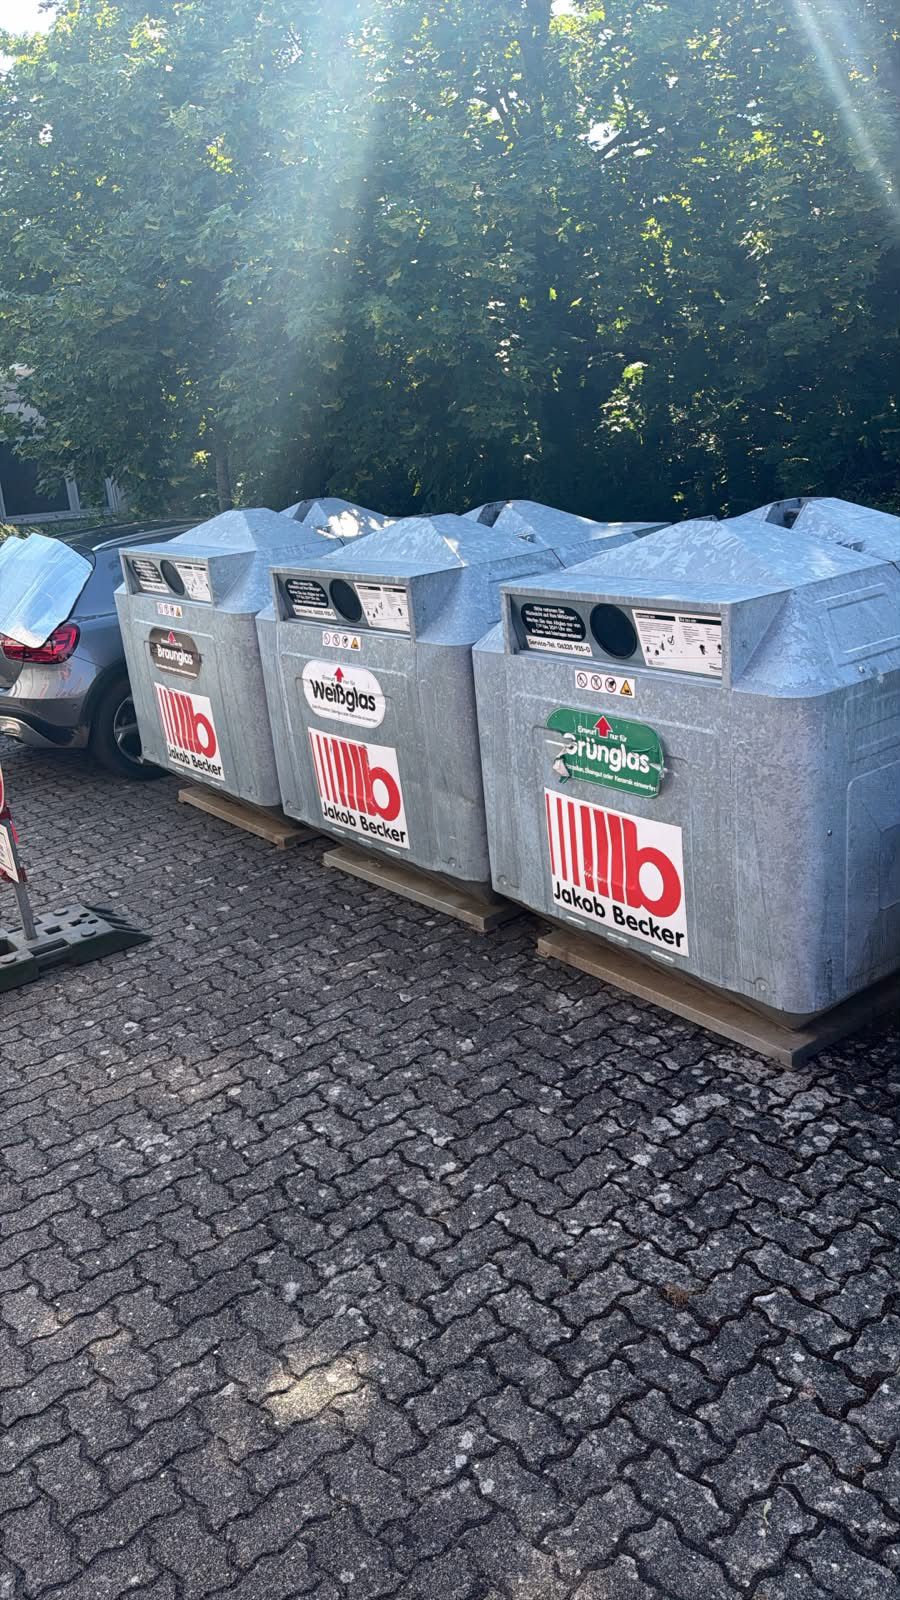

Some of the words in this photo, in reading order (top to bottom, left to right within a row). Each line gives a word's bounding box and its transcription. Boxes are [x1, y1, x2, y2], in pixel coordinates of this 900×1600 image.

[310, 679, 376, 712] Weißglas
[167, 746, 191, 765] Jakob
[190, 755, 222, 777] Becker
[323, 802, 357, 827] Jakob
[359, 815, 406, 843] Becker
[554, 881, 606, 918] Jakob
[612, 905, 685, 948] Becker
